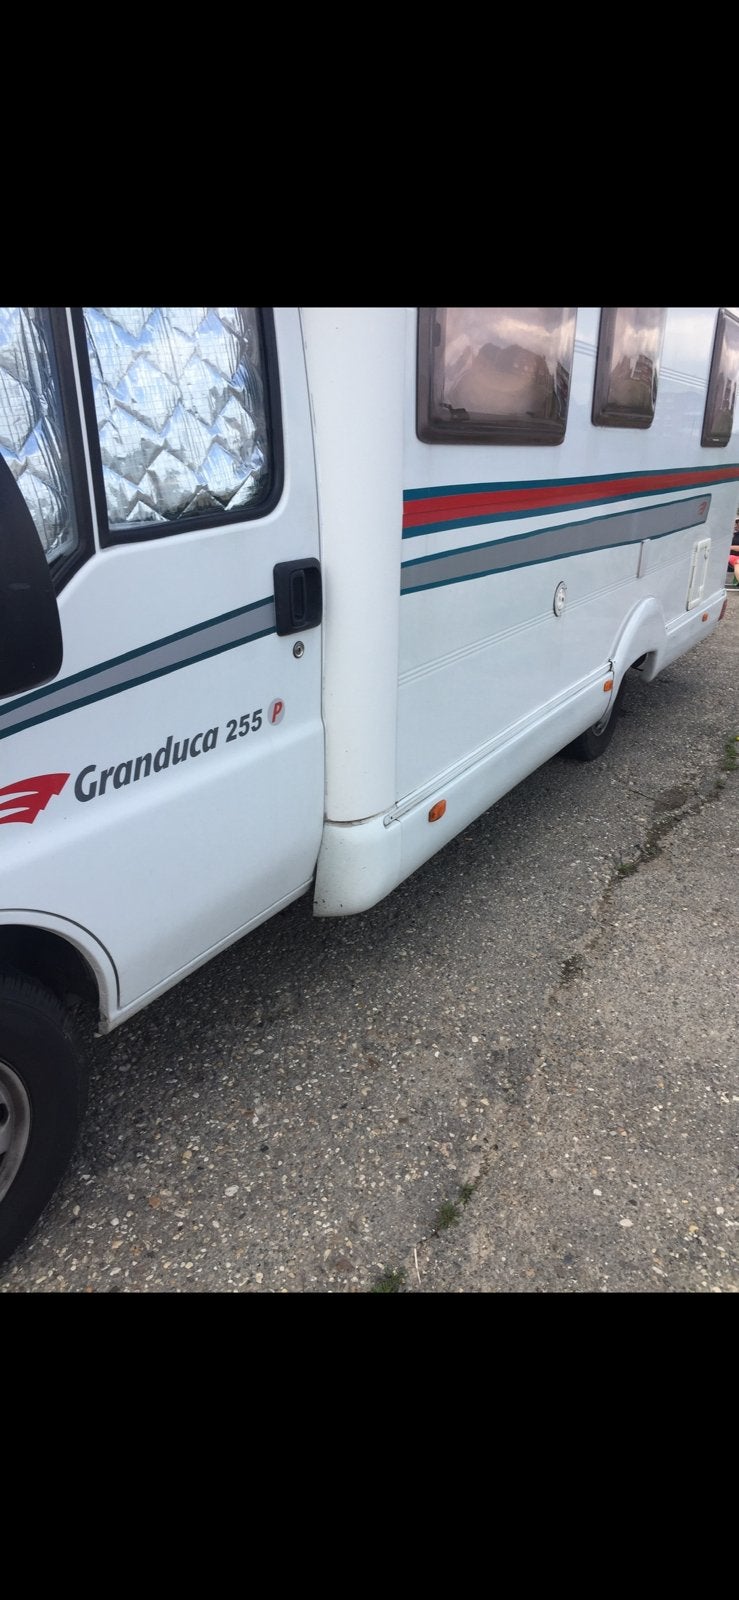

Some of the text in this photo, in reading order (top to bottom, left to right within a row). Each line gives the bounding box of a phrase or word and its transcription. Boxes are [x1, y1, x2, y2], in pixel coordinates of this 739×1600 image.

[74, 700, 284, 802] Granduca 255 P
